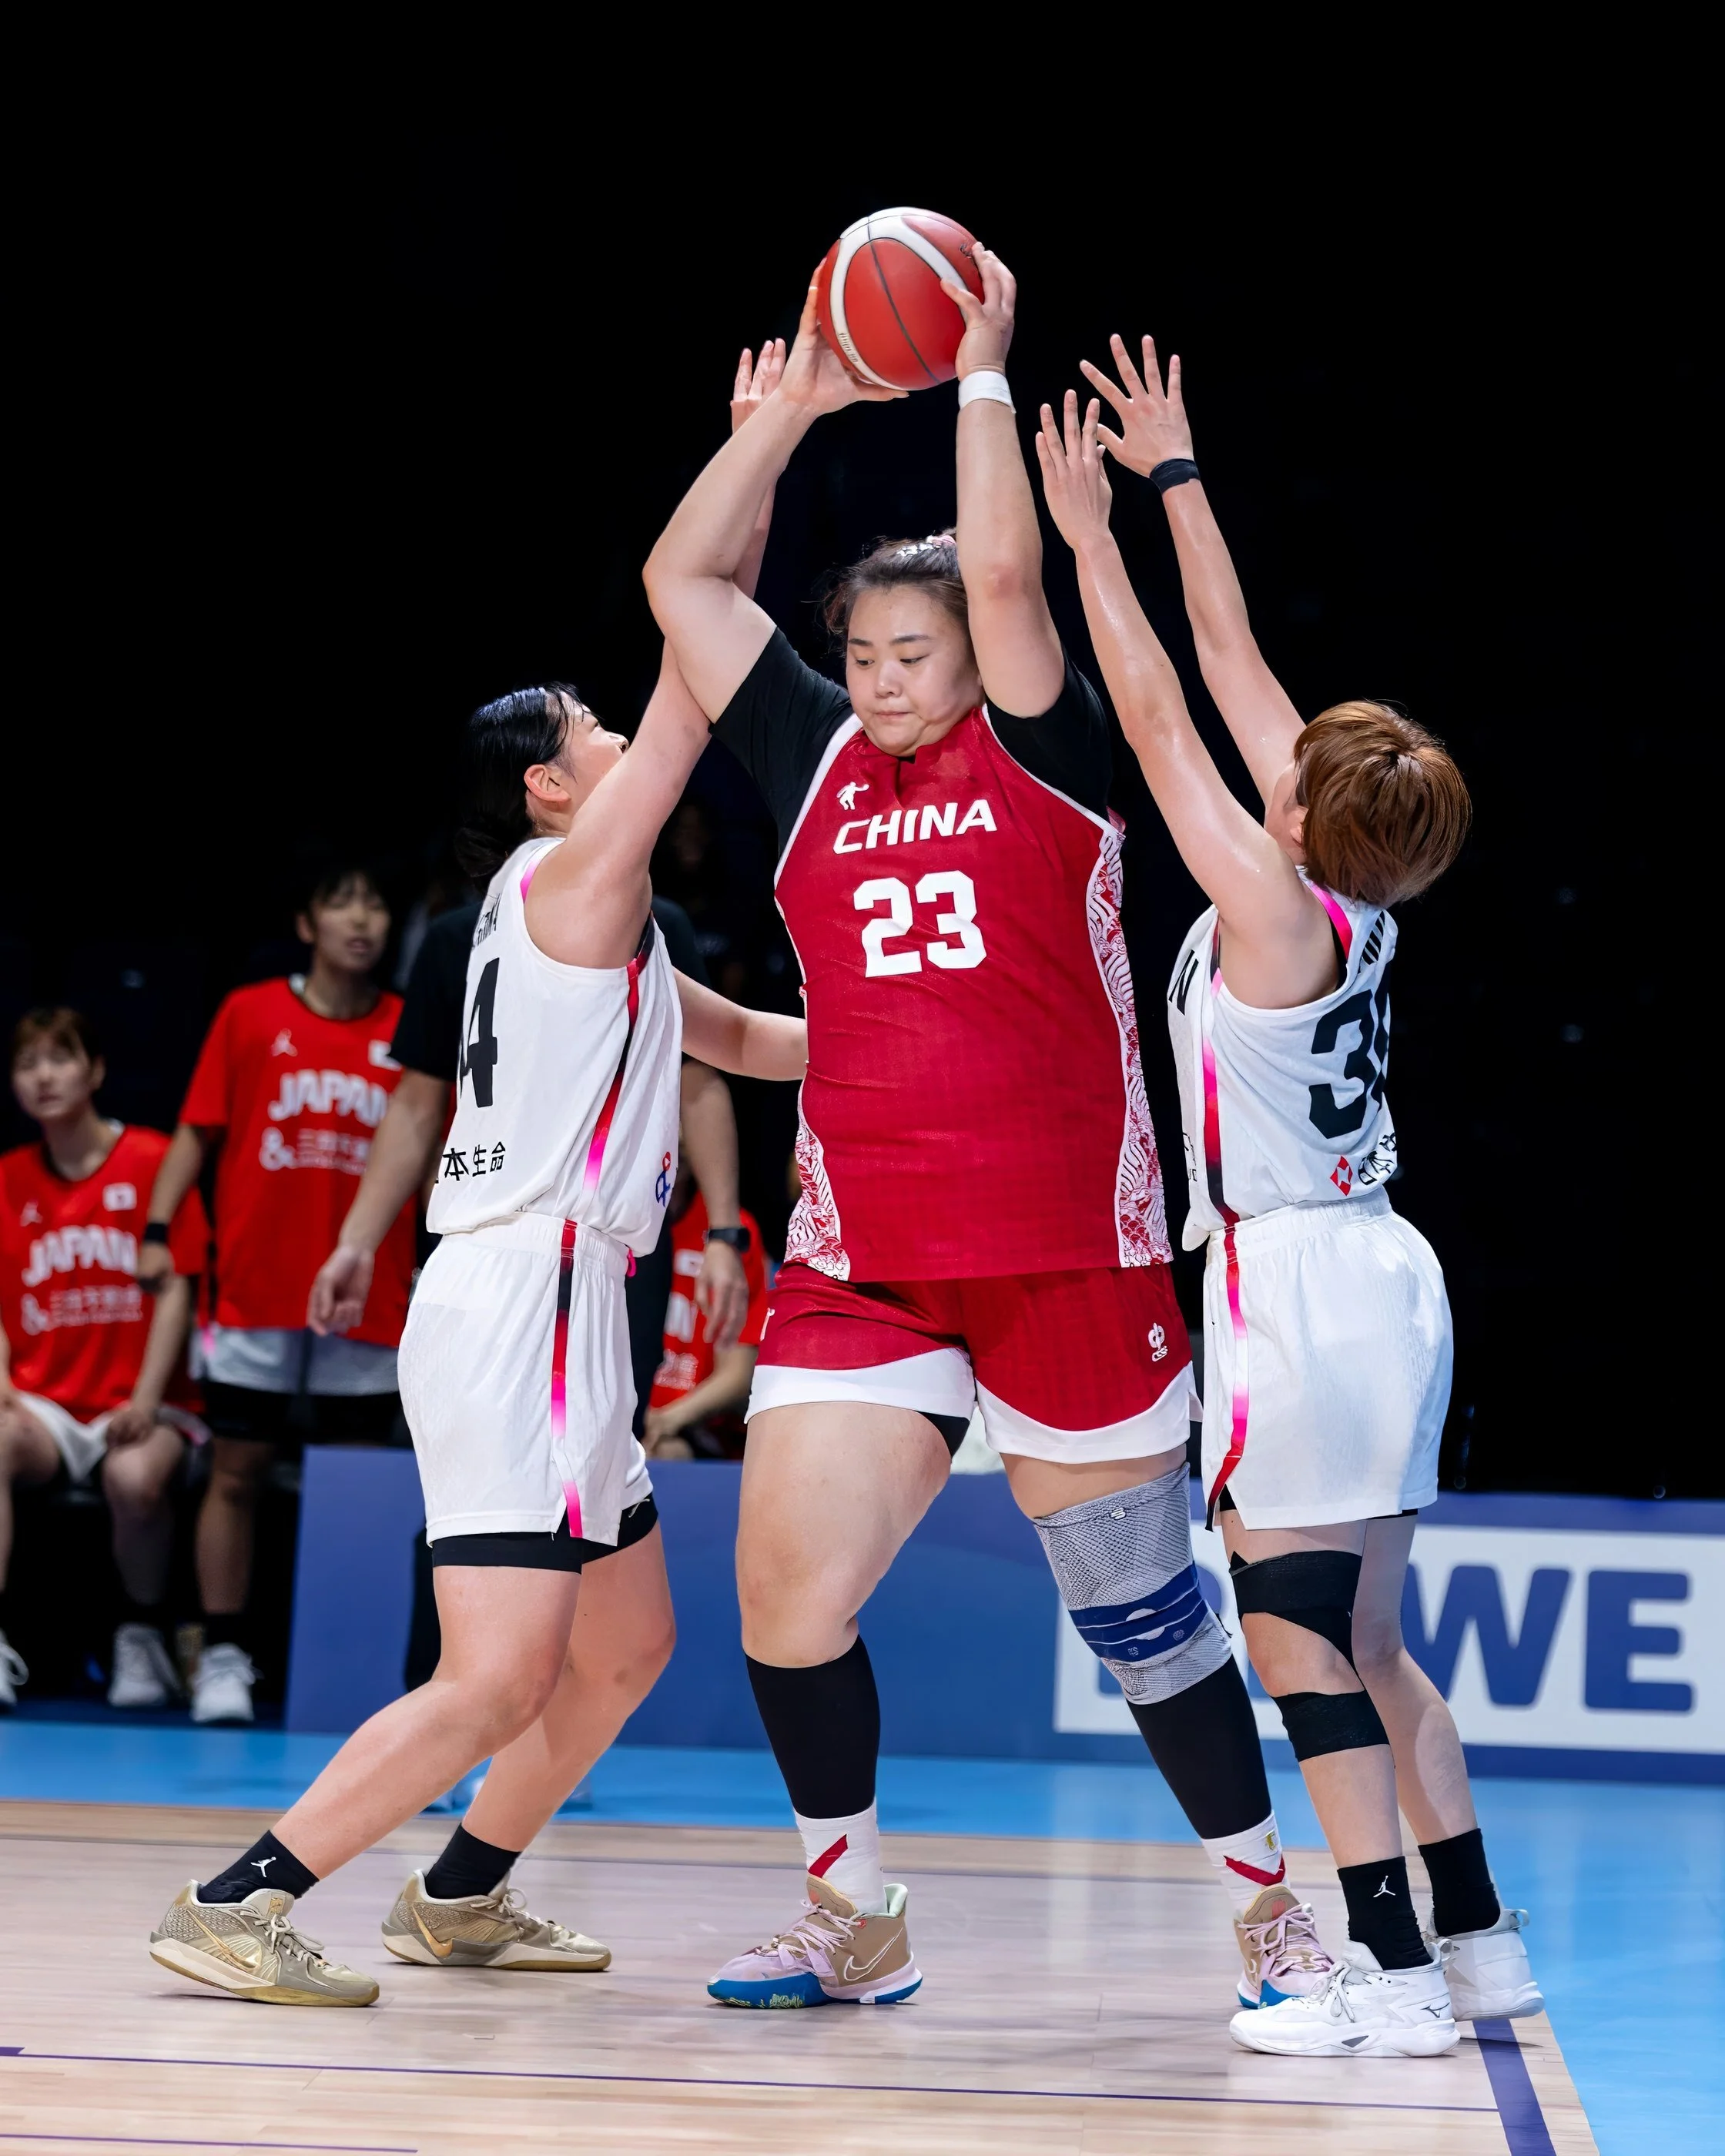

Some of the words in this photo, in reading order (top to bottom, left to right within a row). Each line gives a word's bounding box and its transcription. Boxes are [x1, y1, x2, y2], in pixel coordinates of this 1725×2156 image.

[832, 798, 998, 855] CHINA
[852, 869, 987, 979] 23
[434, 1141, 506, 1184] 本生命
